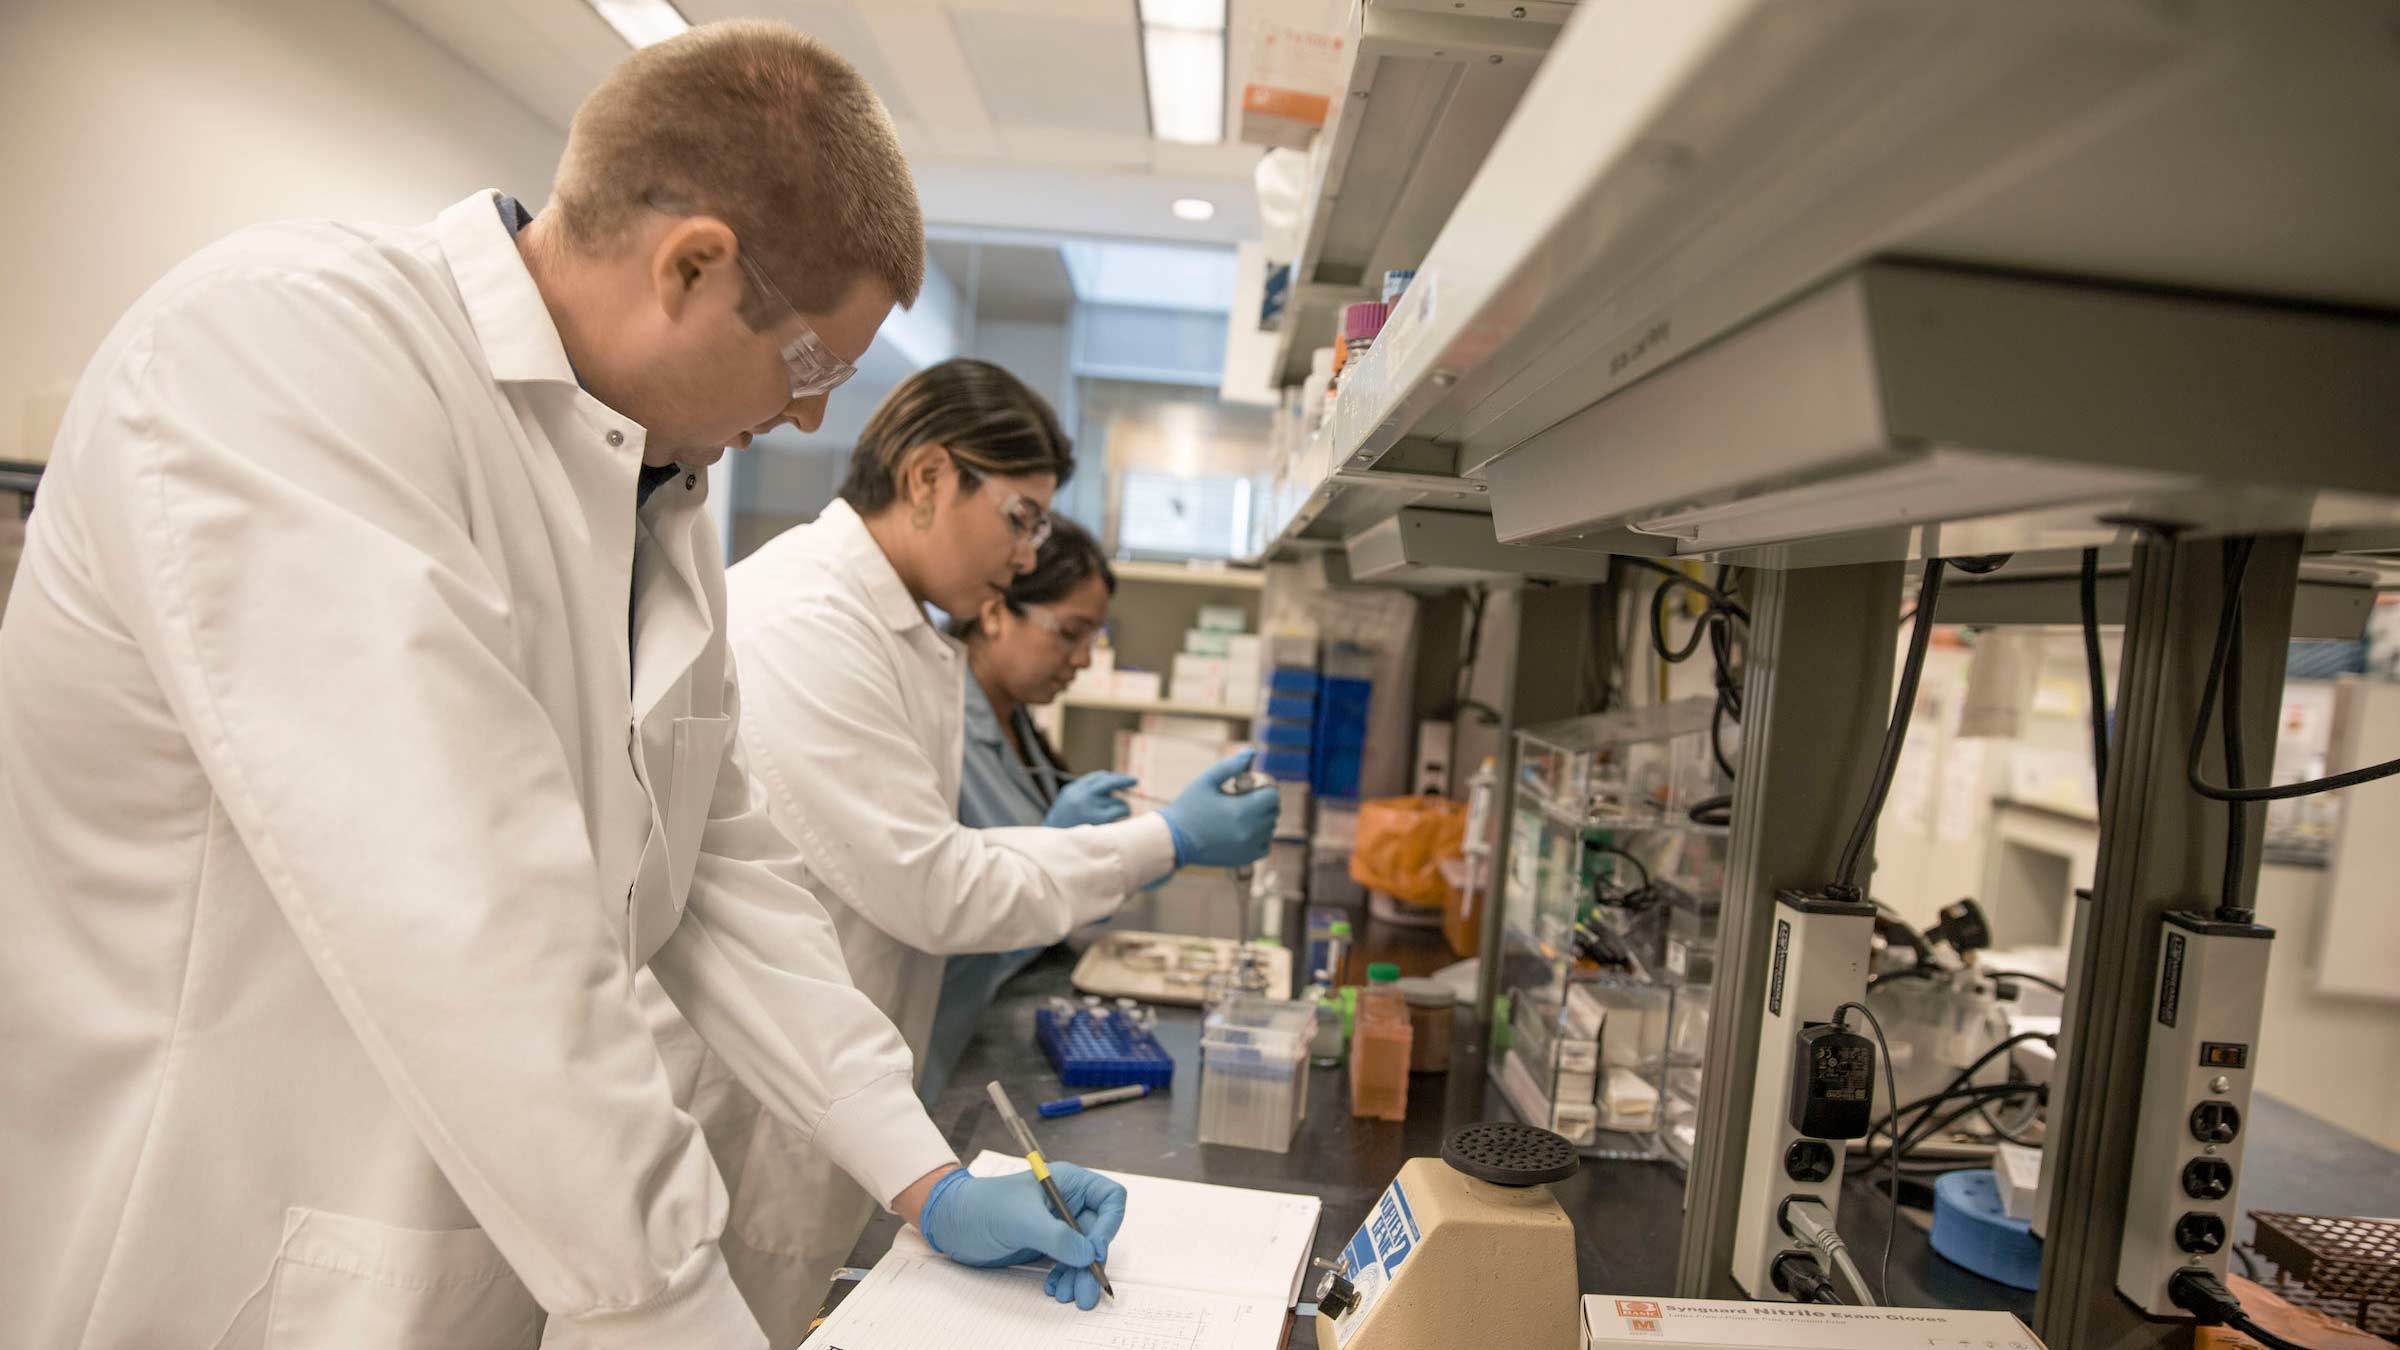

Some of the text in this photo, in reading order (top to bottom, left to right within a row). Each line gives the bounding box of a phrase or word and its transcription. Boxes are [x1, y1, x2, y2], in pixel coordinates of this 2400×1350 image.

[1371, 1215, 1412, 1280] GENIE 2
[1665, 1305, 1748, 1314] Synguard
[1753, 1307, 1826, 1317] Nitrile
[1831, 1312, 1881, 1320] Exam
[1885, 1314, 1947, 1322] Gloves
